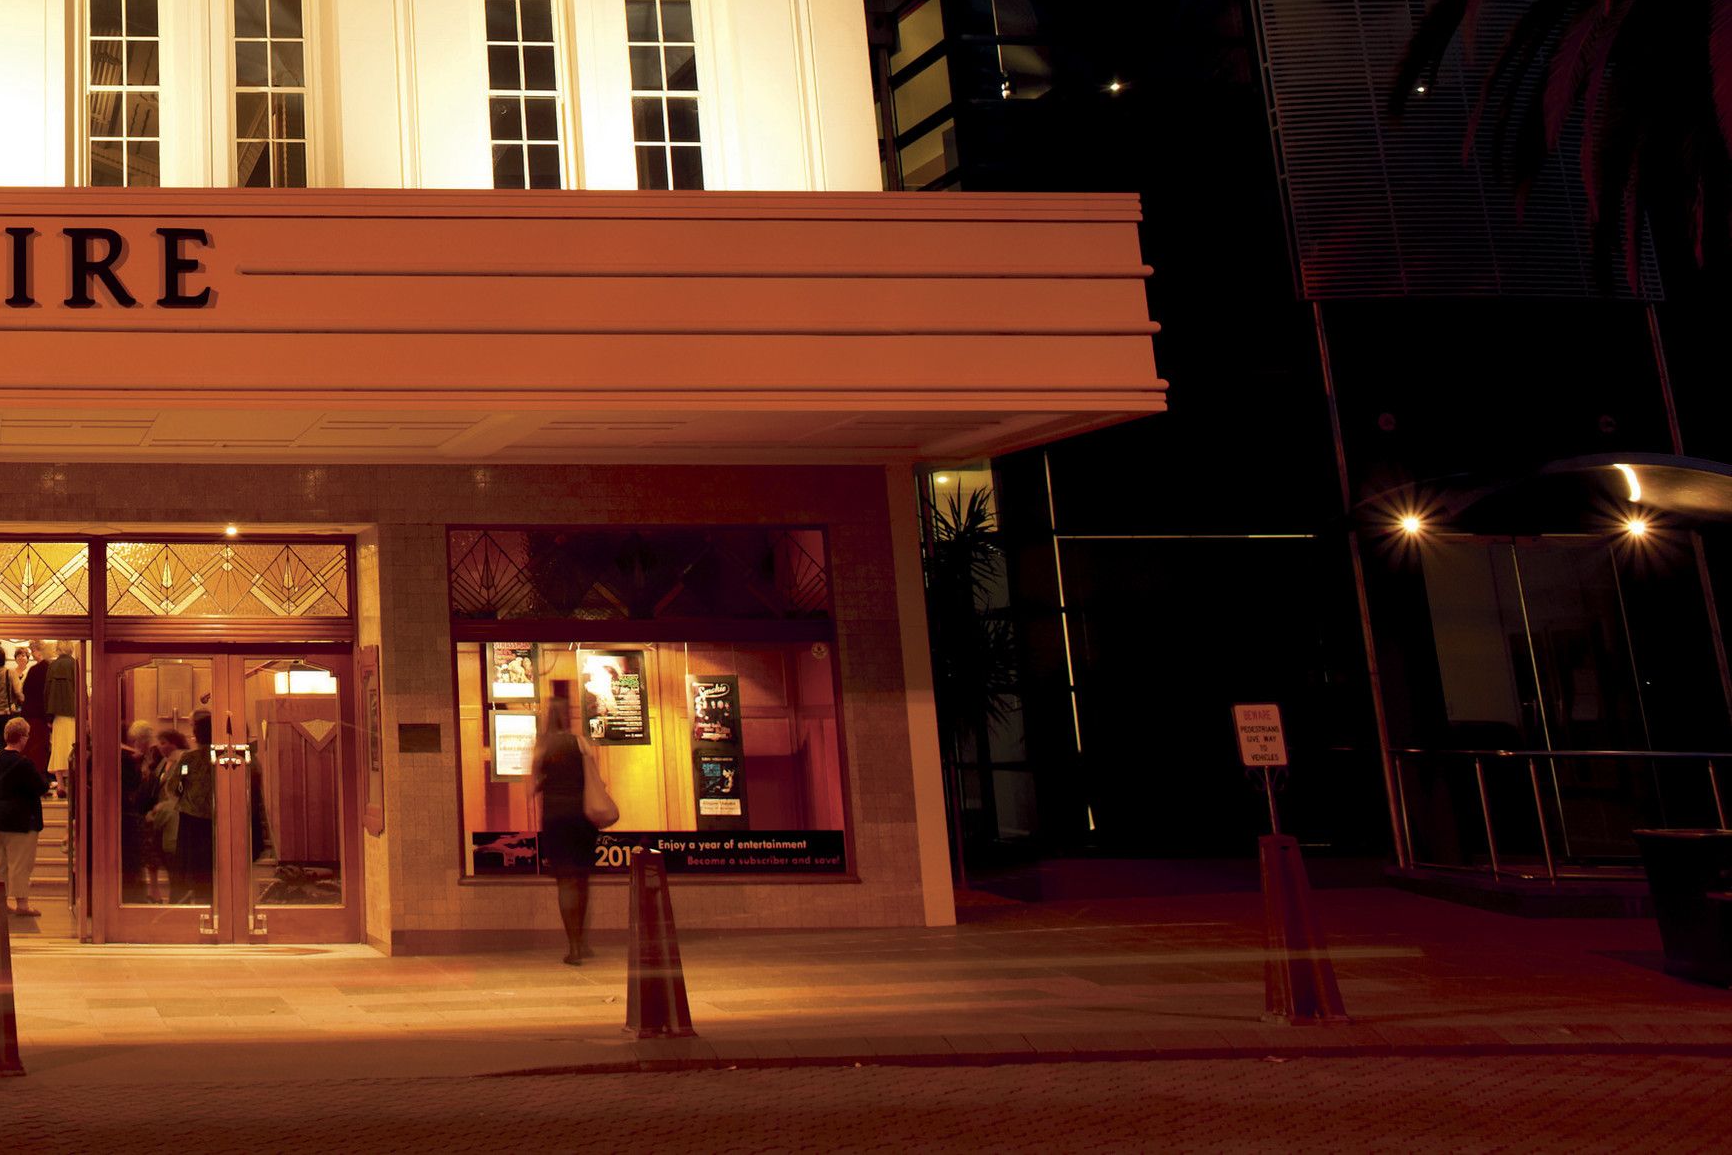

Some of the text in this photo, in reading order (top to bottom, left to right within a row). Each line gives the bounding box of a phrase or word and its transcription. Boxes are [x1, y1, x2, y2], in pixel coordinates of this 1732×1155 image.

[1243, 710, 1272, 720] BEWARE
[658, 839, 685, 851] Enjoy
[698, 842, 720, 851] year
[724, 839, 734, 849] of
[738, 839, 807, 849] entertainment
[595, 845, 644, 867] 201
[688, 856, 726, 865] Become
[739, 856, 789, 865] subscriber
[792, 856, 811, 865] and
[815, 856, 841, 865] save!
